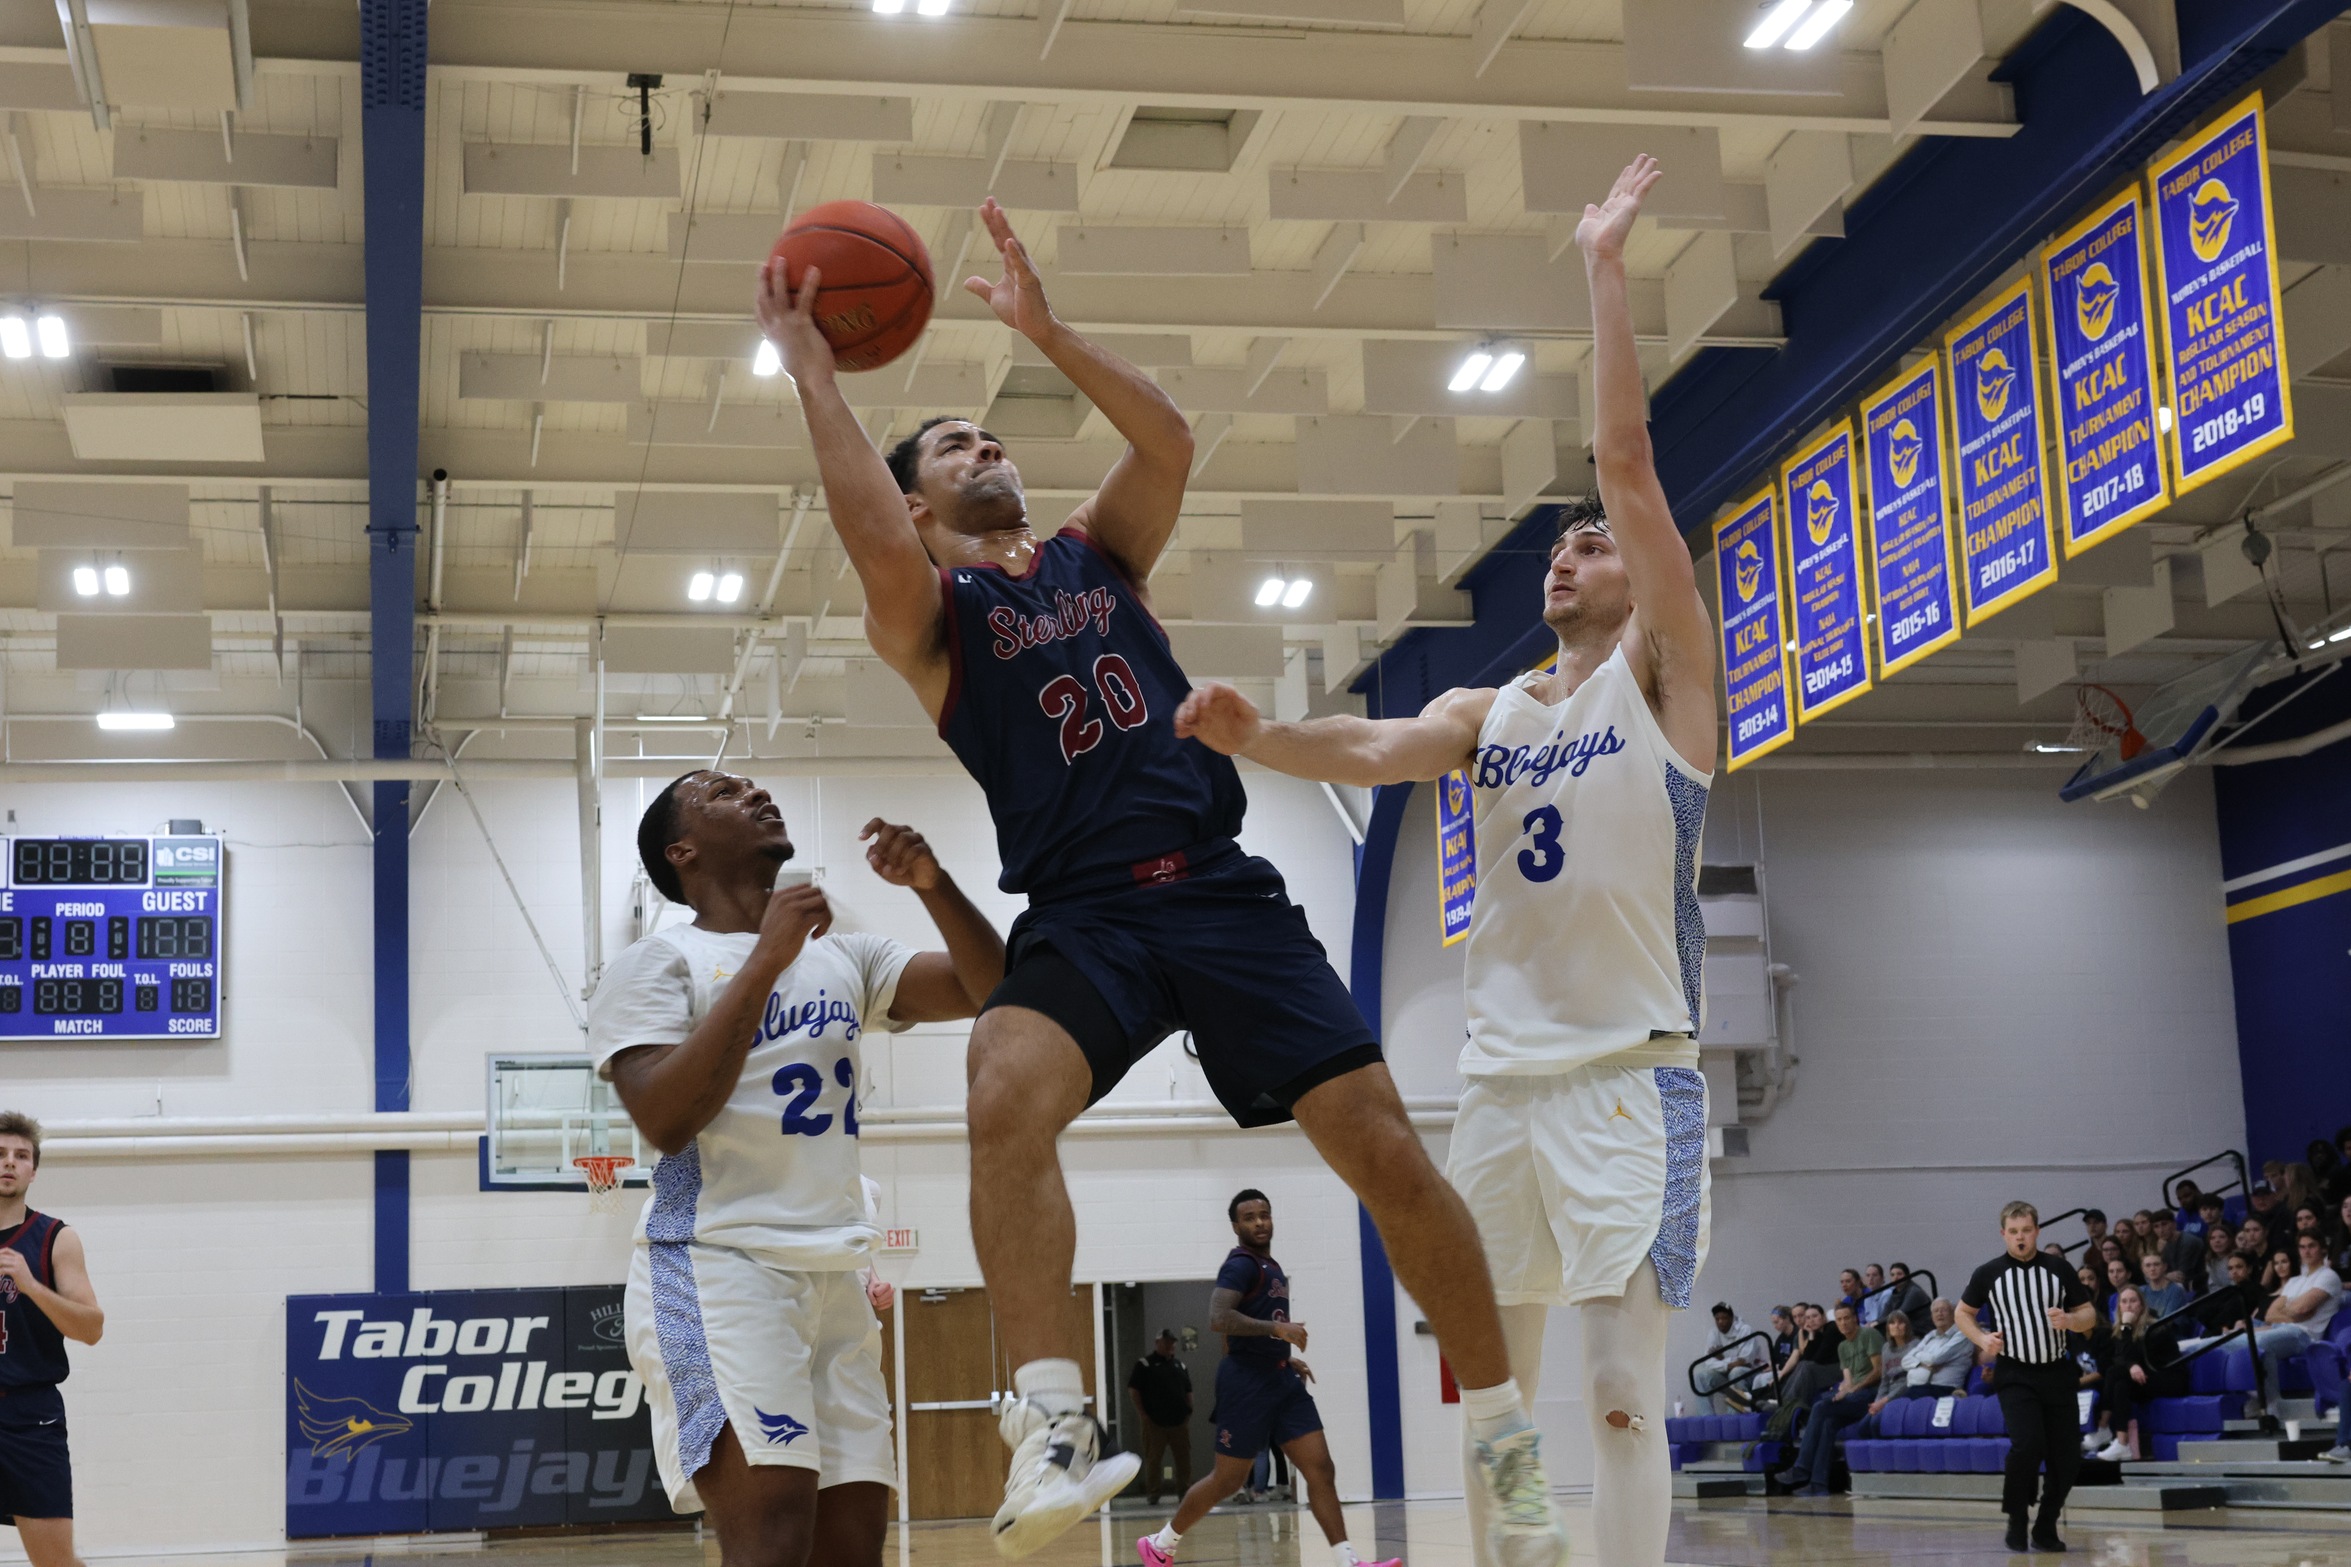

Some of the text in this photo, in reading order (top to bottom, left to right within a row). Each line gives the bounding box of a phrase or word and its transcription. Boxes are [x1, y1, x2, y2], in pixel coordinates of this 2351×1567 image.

[2162, 128, 2254, 201] TABOR COLLEGE
[2052, 216, 2133, 282] TABOR COLLEGE
[2208, 241, 2263, 282] BASKETBALL
[2186, 273, 2248, 338] KCAC
[1955, 306, 2025, 366] TABOR COLLEGE
[2178, 301, 2267, 366] REGULAR SEASON
[2198, 323, 2270, 374] TOURNAMENT
[2075, 352, 2127, 411] KCAC
[2180, 343, 2273, 417] CHAMPION
[1870, 382, 1932, 434] TABOR COLLEGE
[1992, 405, 2032, 438] BASKETBALL
[2192, 392, 2265, 453] 2018-19
[1974, 432, 2024, 487] KCAC
[2068, 416, 2150, 484] CHAMPION
[1966, 466, 2036, 521] TOURNAMENT
[2083, 463, 2144, 518] 2017-18
[1743, 507, 1770, 537] COLLEGE
[1967, 495, 2041, 557] CHAMPION
[1980, 538, 2035, 589] 2016-17
[1735, 615, 1769, 657] KCAC
[1891, 600, 1940, 646] 2015-16
[1728, 644, 1778, 685] TOURNAMENT
[1805, 653, 1853, 694] 2014-15
[1038, 653, 1148, 766] 20
[1728, 668, 1782, 715] CHAMPION
[1738, 703, 1778, 742] 2013-14
[175, 847, 215, 861] CSI
[1517, 804, 1566, 882] 3
[55, 902, 105, 917] PERIOD
[142, 891, 208, 912] GUEST
[31, 963, 127, 978] PLAYER FOUL
[134, 973, 161, 985] T.O.L.
[169, 963, 213, 977] FOULS
[54, 1019, 103, 1034] MATCH
[168, 1018, 212, 1033] SCORE
[751, 989, 861, 1049] luejay
[887, 1229, 911, 1247] EXIT
[313, 1308, 549, 1360] Tabor
[398, 1361, 651, 1420] Colleg
[287, 1439, 662, 1512] Bluejay
